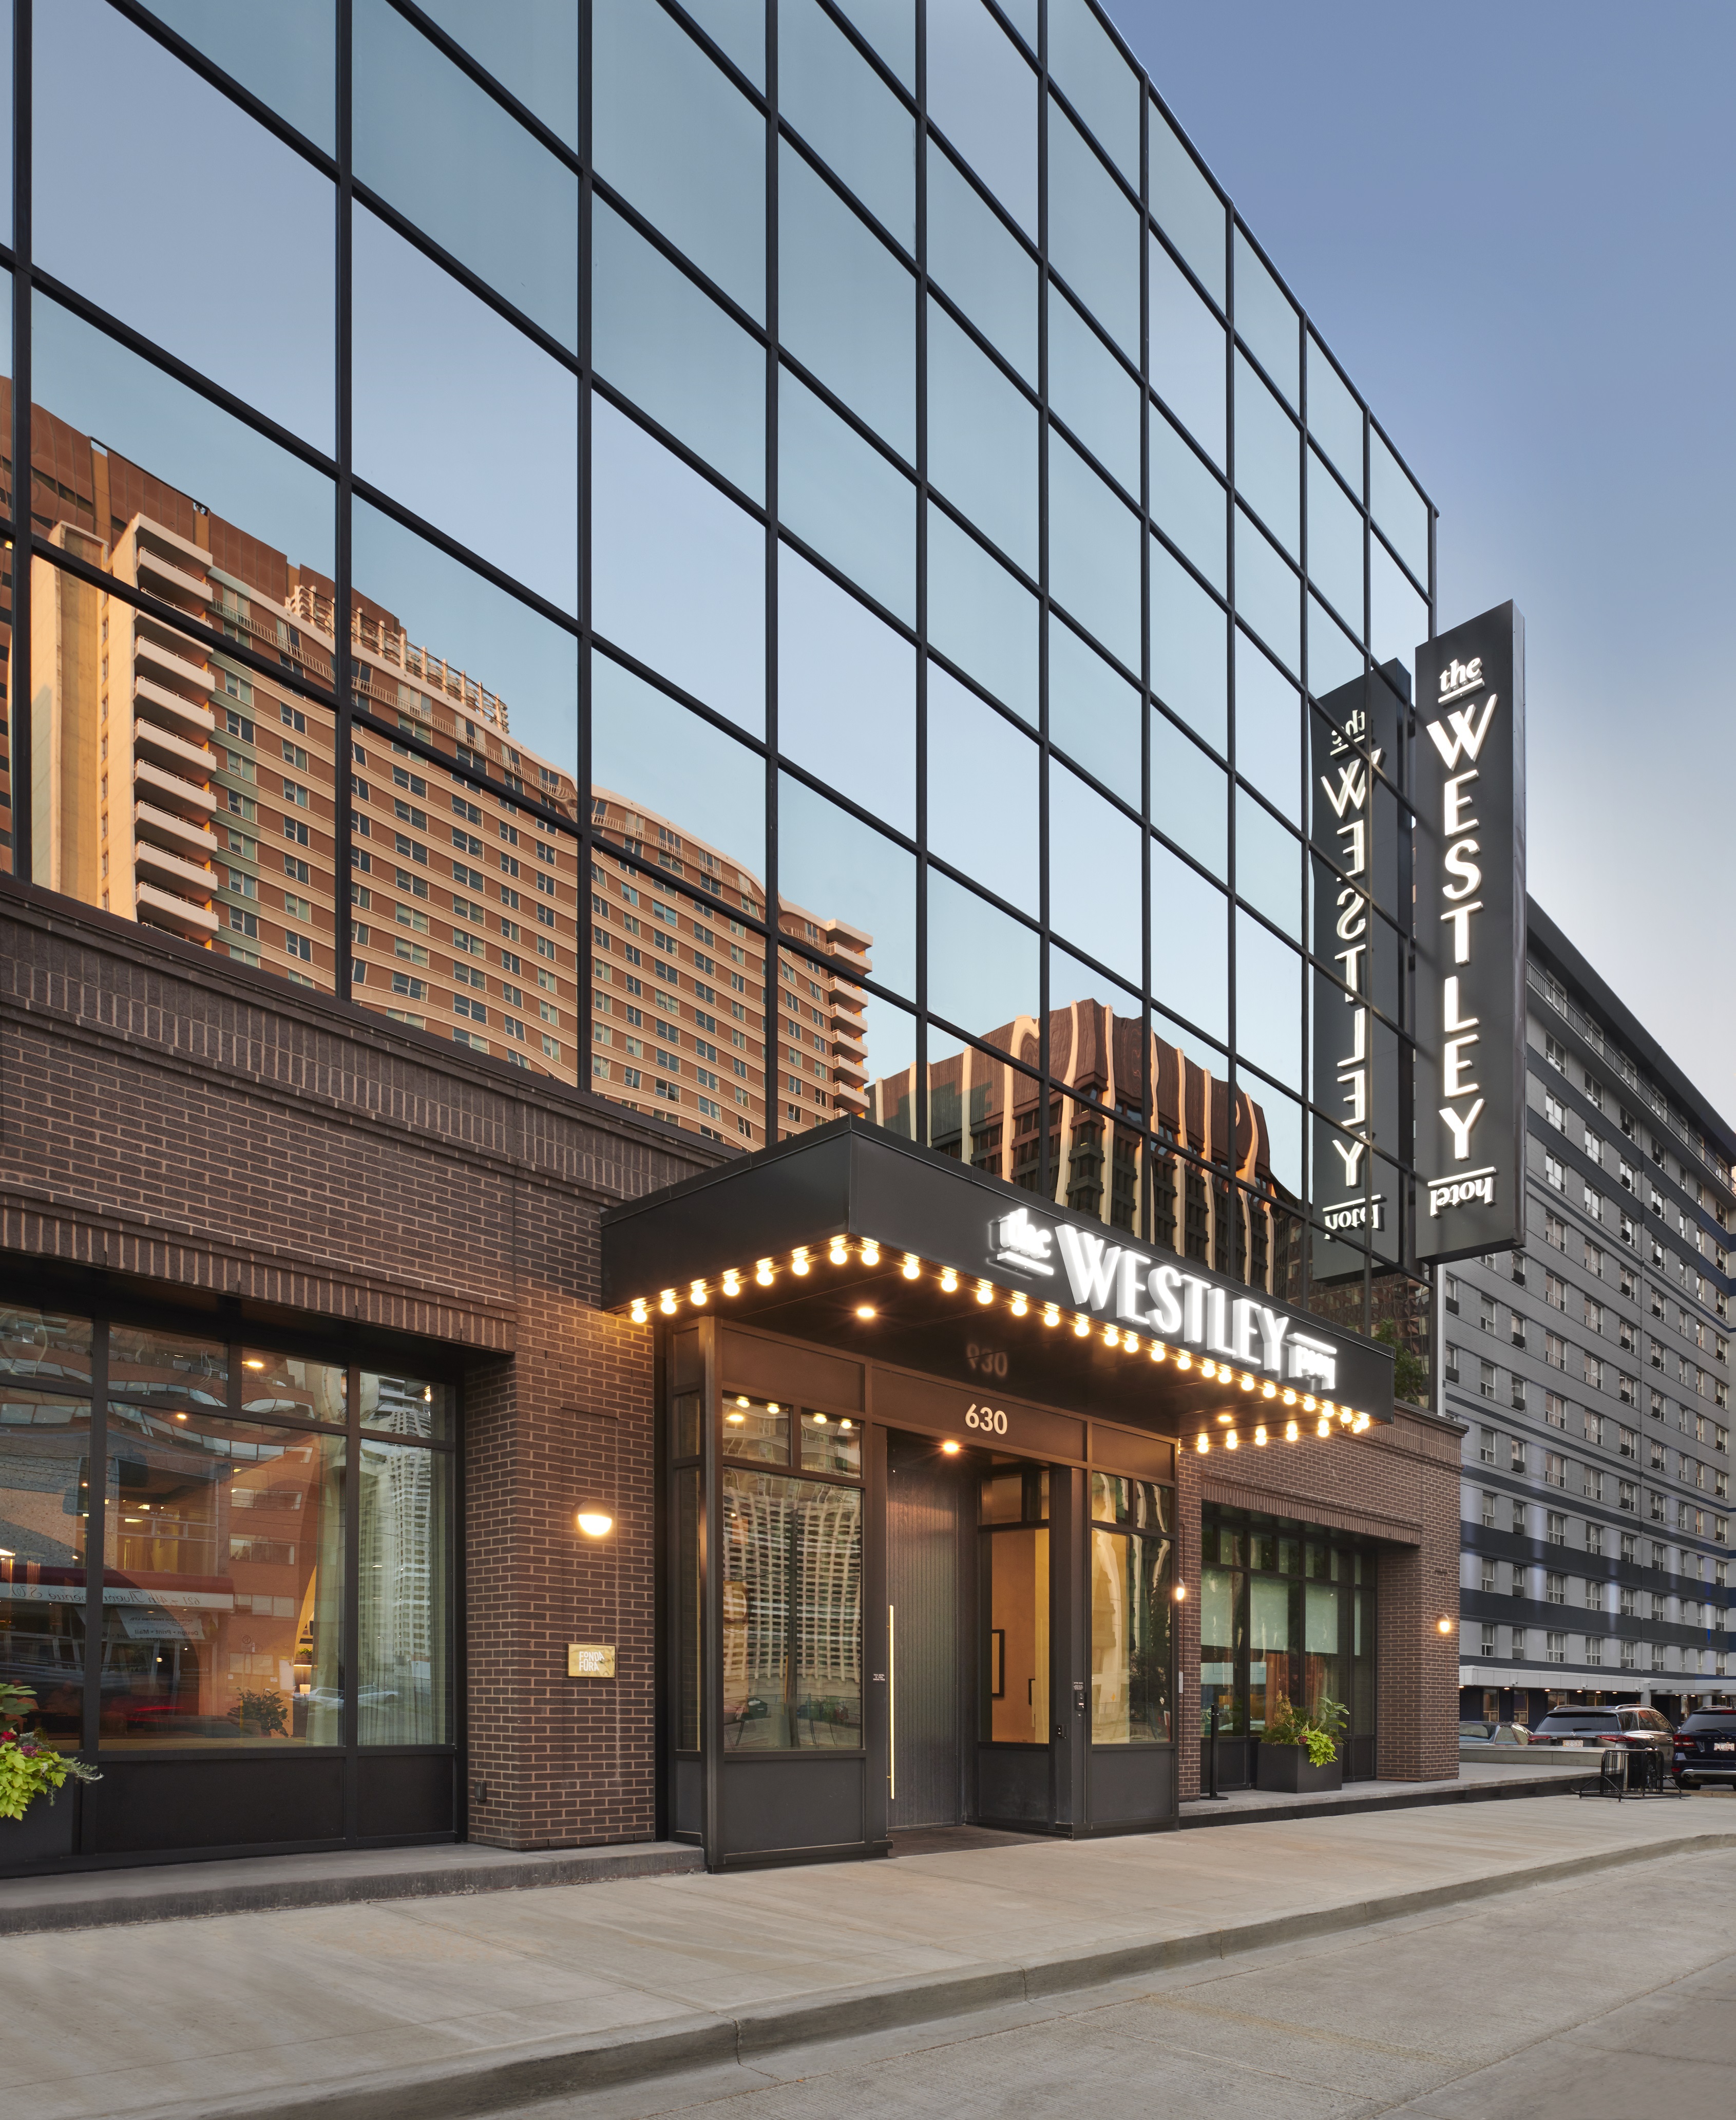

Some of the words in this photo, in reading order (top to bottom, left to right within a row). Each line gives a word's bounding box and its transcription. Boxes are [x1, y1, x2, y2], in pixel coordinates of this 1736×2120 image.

[1439, 657, 1483, 694] the
[1426, 693, 1498, 1161] WESTLEY
[1429, 1177, 1495, 1217] hotel
[998, 1208, 1052, 1259] the
[1055, 1224, 1289, 1372] WESTLEY
[965, 1404, 1007, 1434] 630
[579, 1658, 600, 1672] FORA
